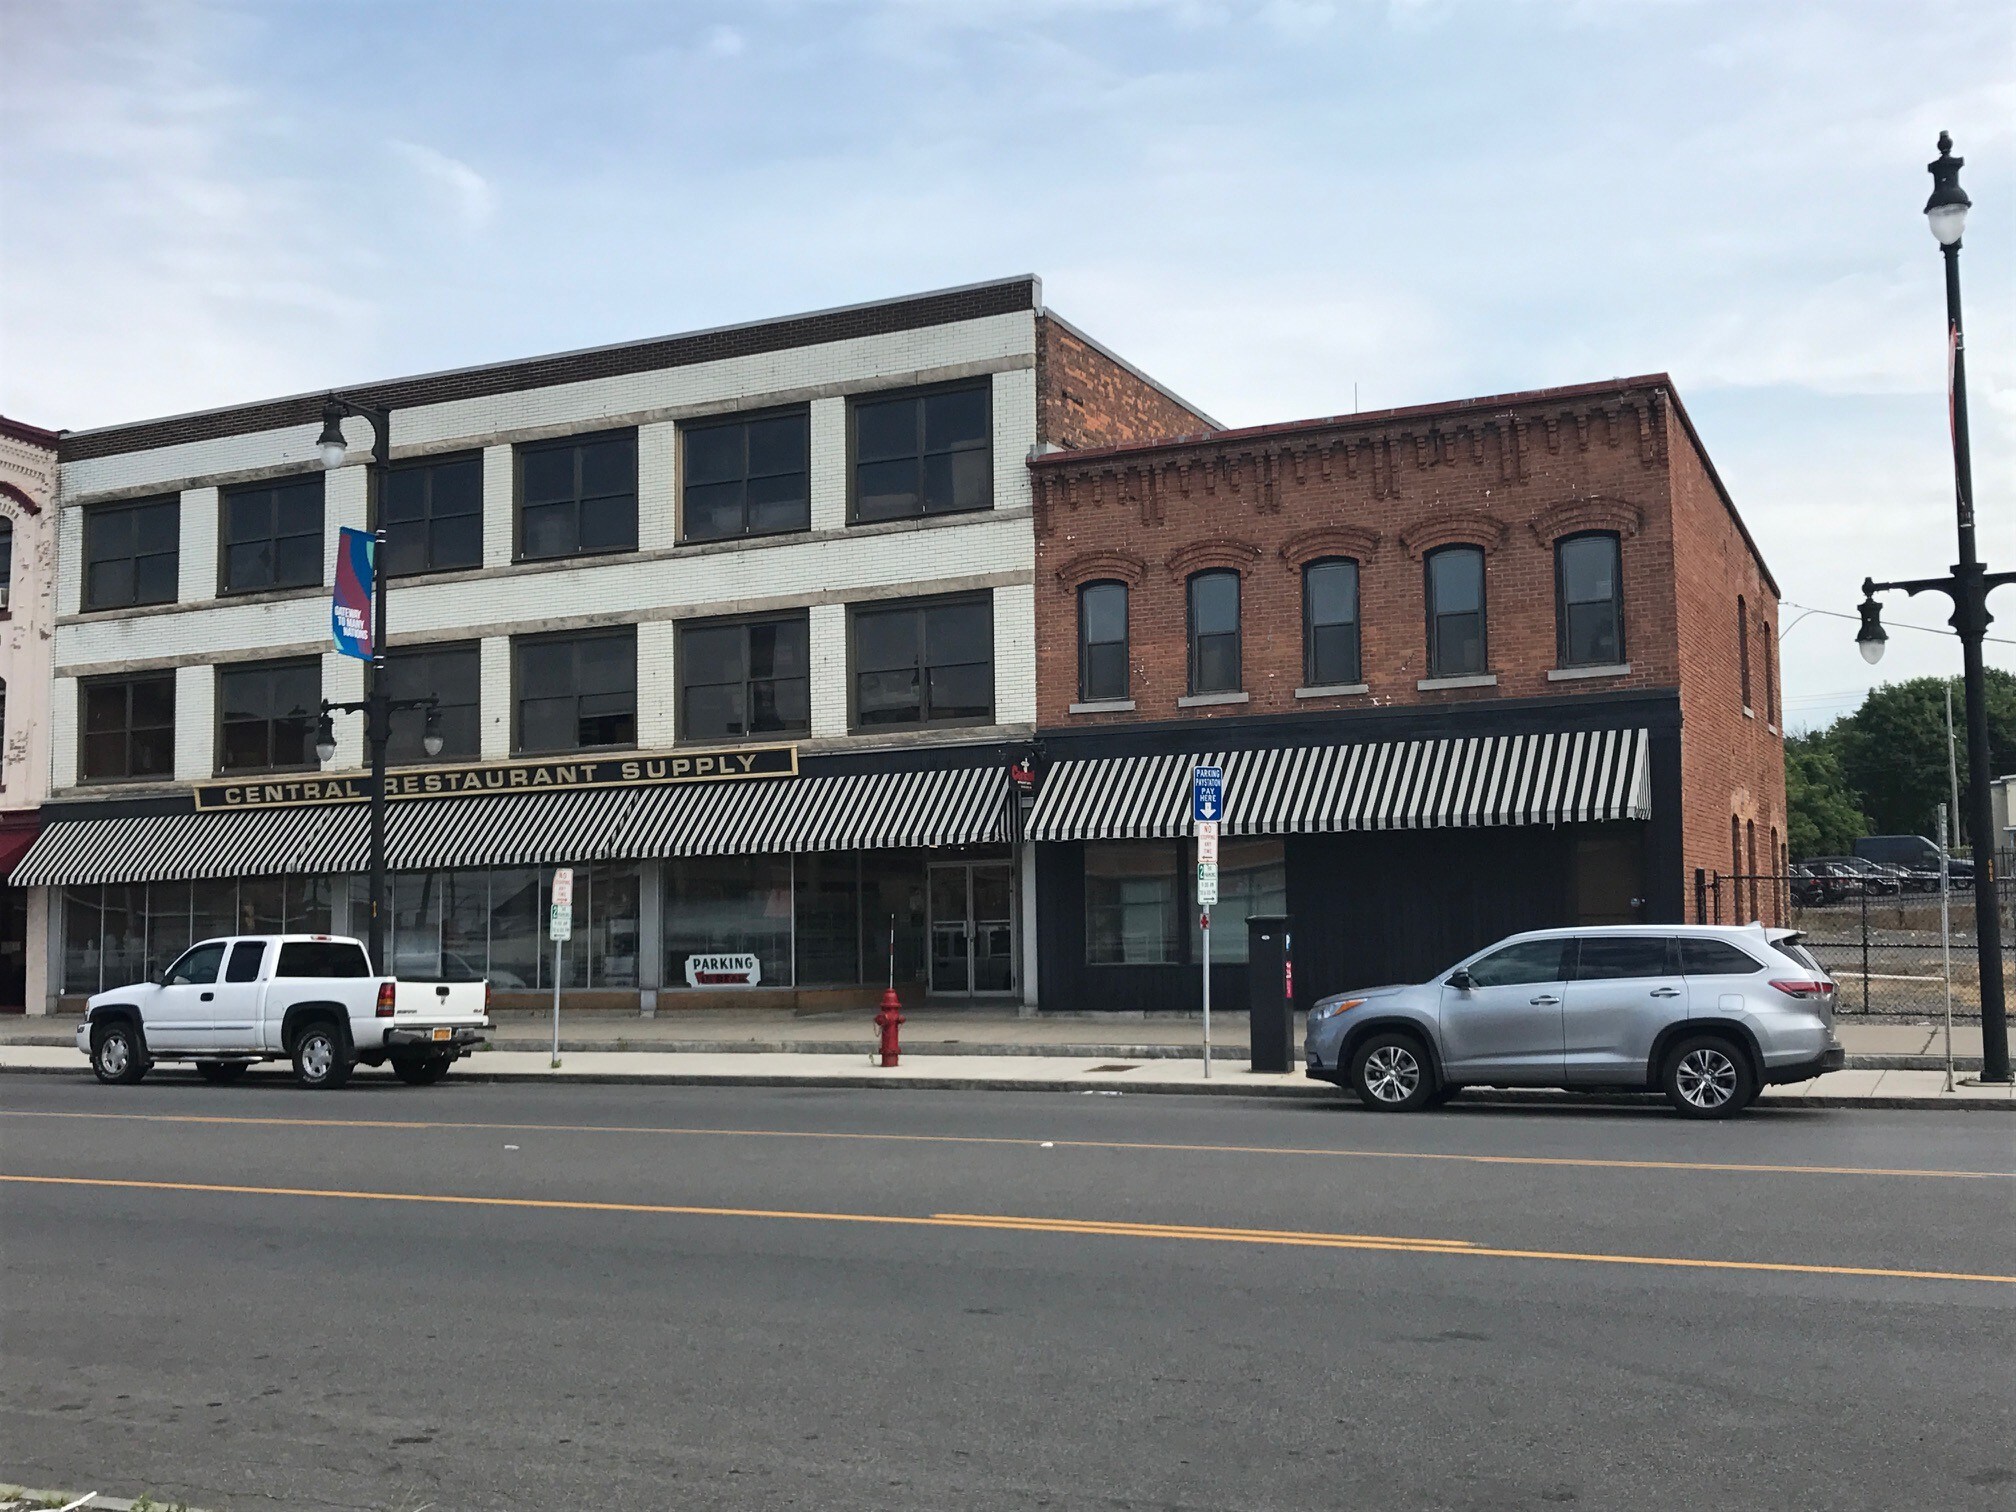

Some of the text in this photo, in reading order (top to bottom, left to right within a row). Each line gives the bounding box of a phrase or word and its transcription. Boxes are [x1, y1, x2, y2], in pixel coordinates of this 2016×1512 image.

[337, 616, 364, 629] TO MANY
[343, 627, 368, 639] NATIONS
[225, 754, 757, 804] CENTRAL RESTAURANT SUPPLY
[1196, 769, 1220, 778] PARKING
[1195, 778, 1221, 787] PAYSTATION
[1201, 787, 1215, 795] PAY
[1204, 825, 1212, 833] NO
[1199, 865, 1204, 879] 2
[552, 905, 558, 919] 2
[693, 957, 753, 970] PARKING
